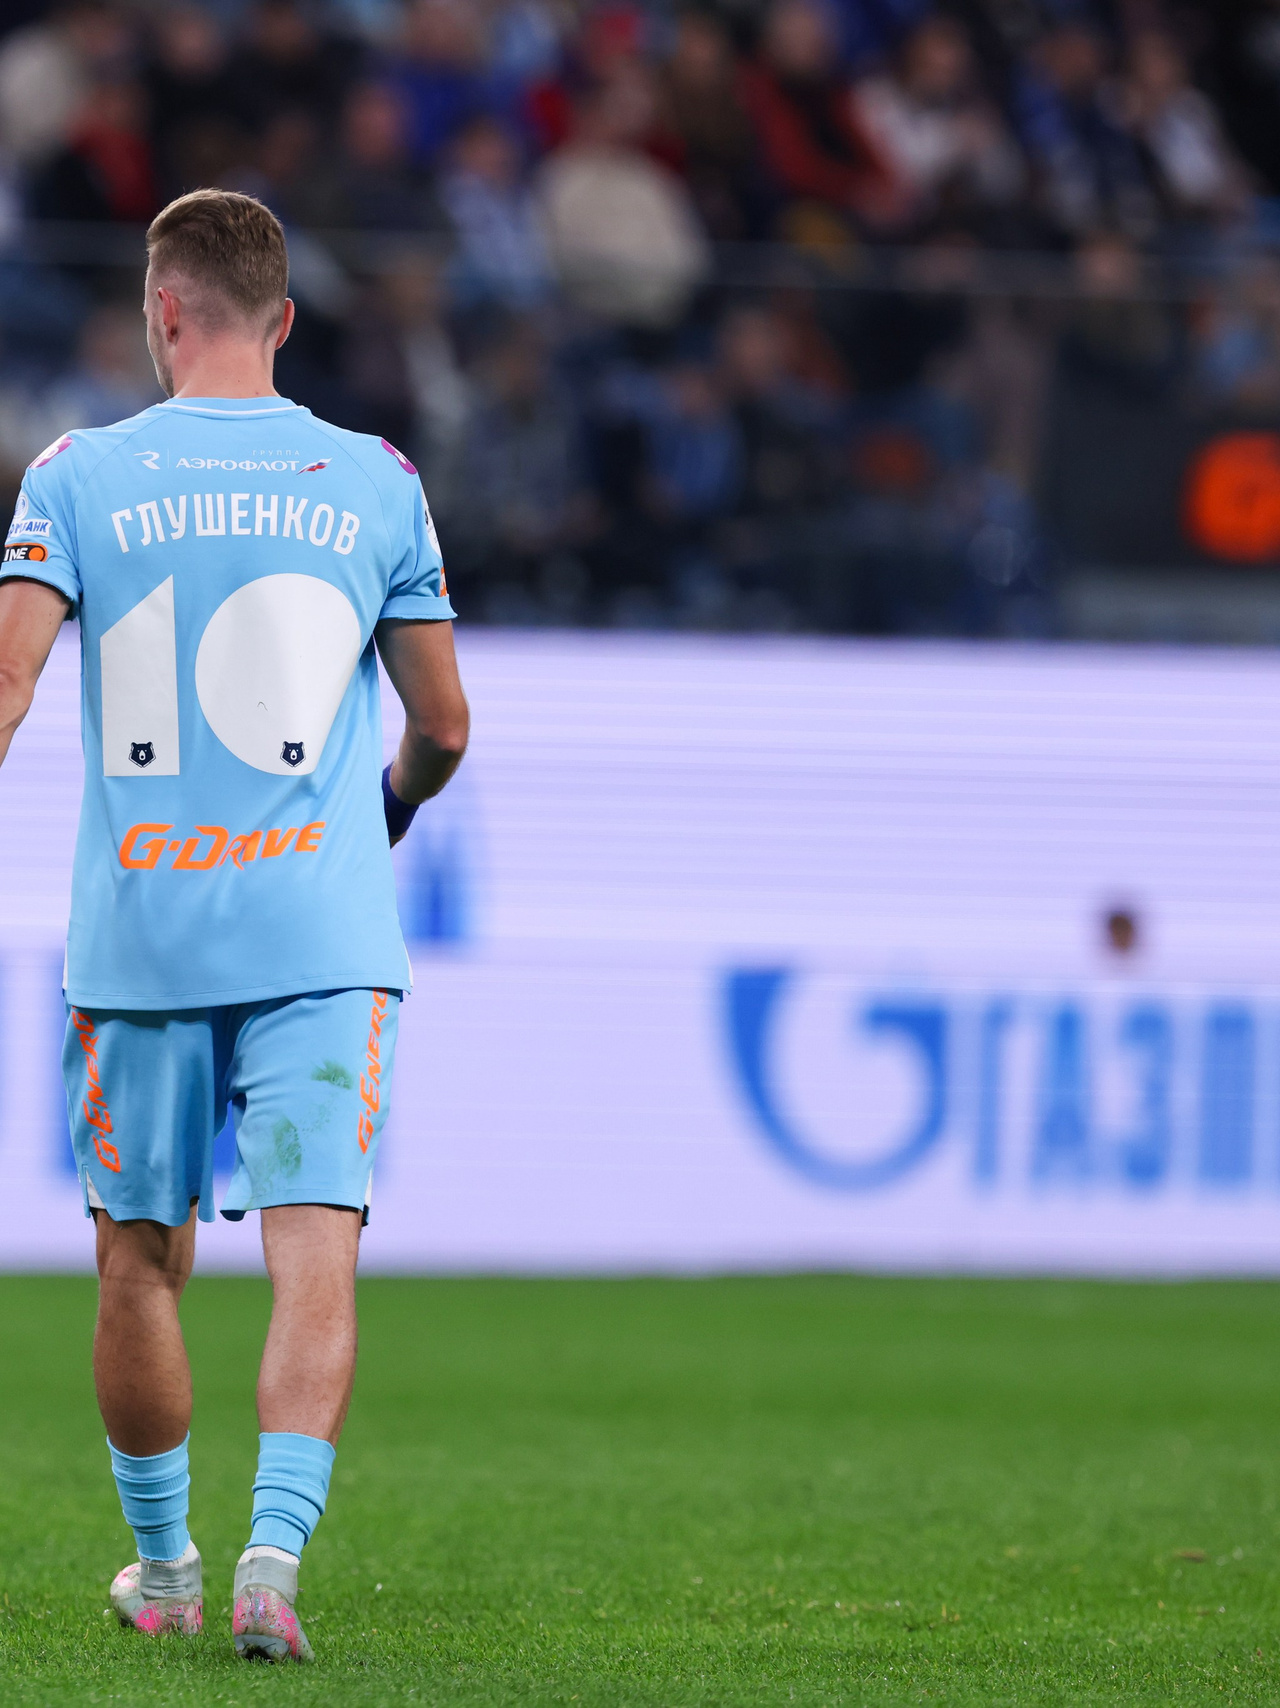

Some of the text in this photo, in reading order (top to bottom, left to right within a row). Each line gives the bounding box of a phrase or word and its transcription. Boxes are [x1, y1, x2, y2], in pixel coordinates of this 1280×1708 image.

[175, 457, 300, 472] АЭРОФЛОТ
[111, 493, 361, 555] ГЛУШЕНКОВ
[4, 547, 28, 561] INE
[100, 573, 361, 777] 10
